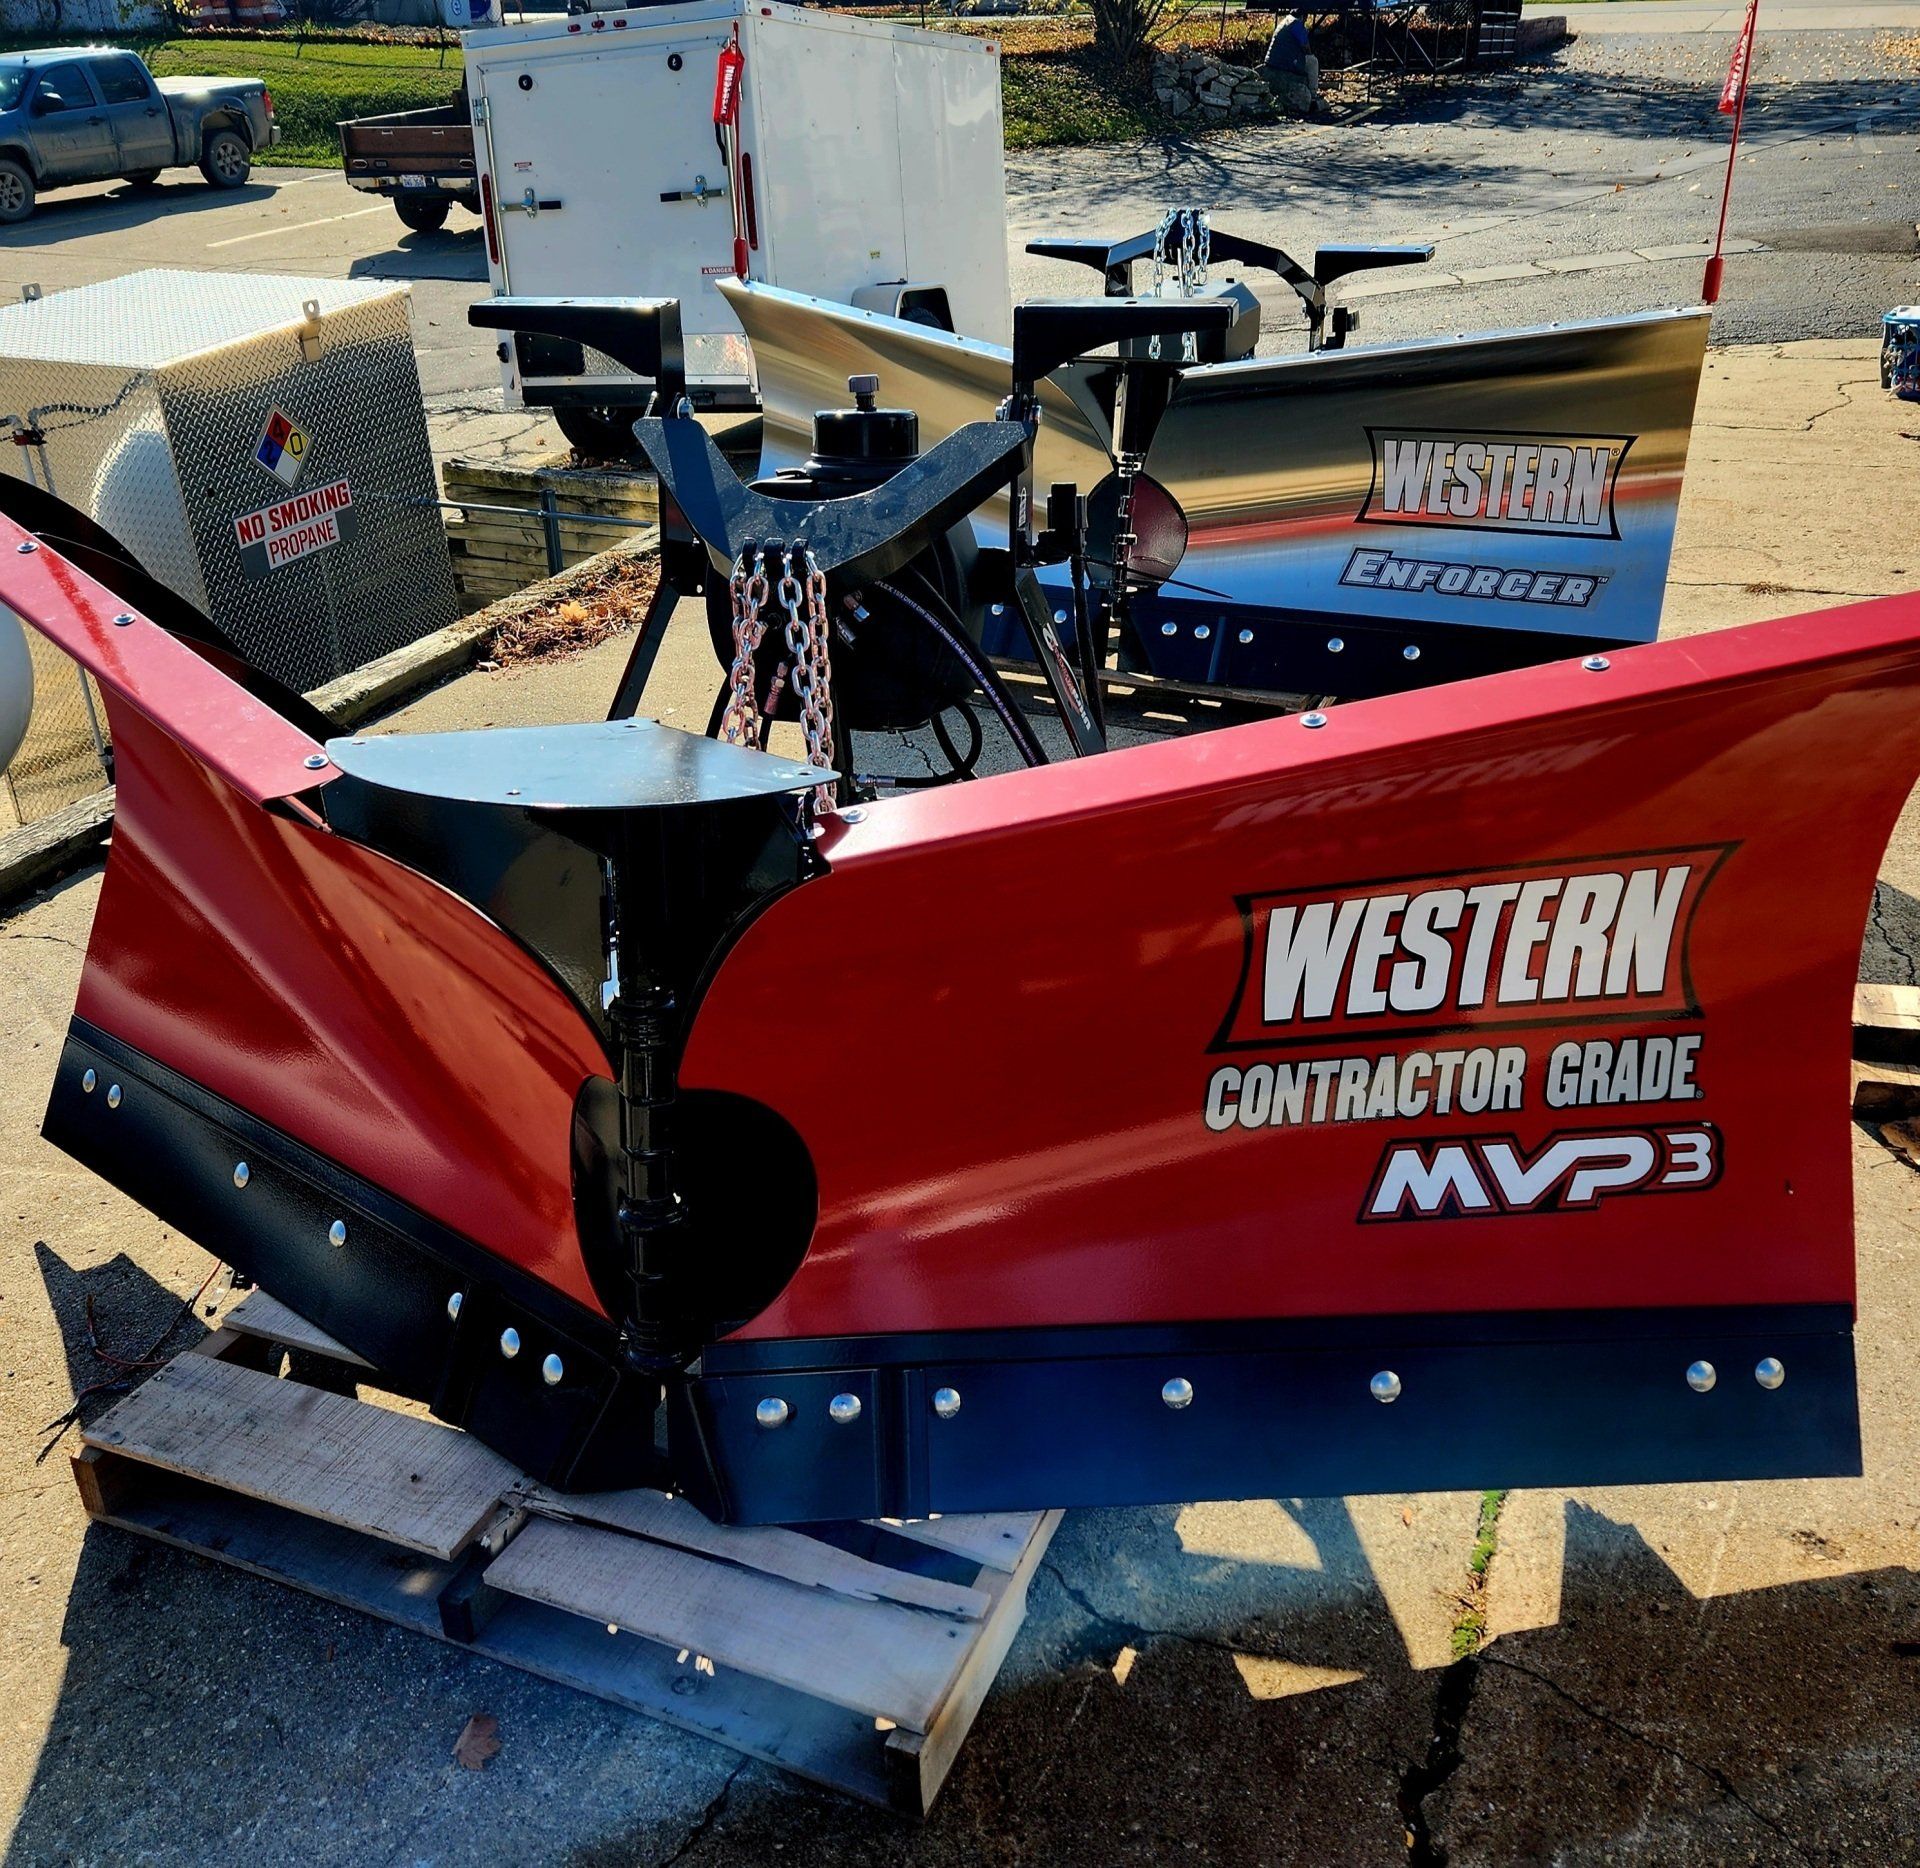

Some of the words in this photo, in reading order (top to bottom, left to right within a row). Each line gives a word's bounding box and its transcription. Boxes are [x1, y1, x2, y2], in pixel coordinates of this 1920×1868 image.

[265, 440, 275, 465] 2
[289, 432, 303, 456] 0
[272, 419, 285, 439] 4
[237, 514, 266, 545] NO
[268, 482, 350, 533] SMOKING
[1383, 439, 1611, 526] WESTERN
[269, 518, 337, 564] PROPANE
[1263, 865, 1692, 1022] WESTERN
[1204, 1046, 1527, 1132] CONTRACTOR
[1545, 1034, 1702, 1108] GRADE
